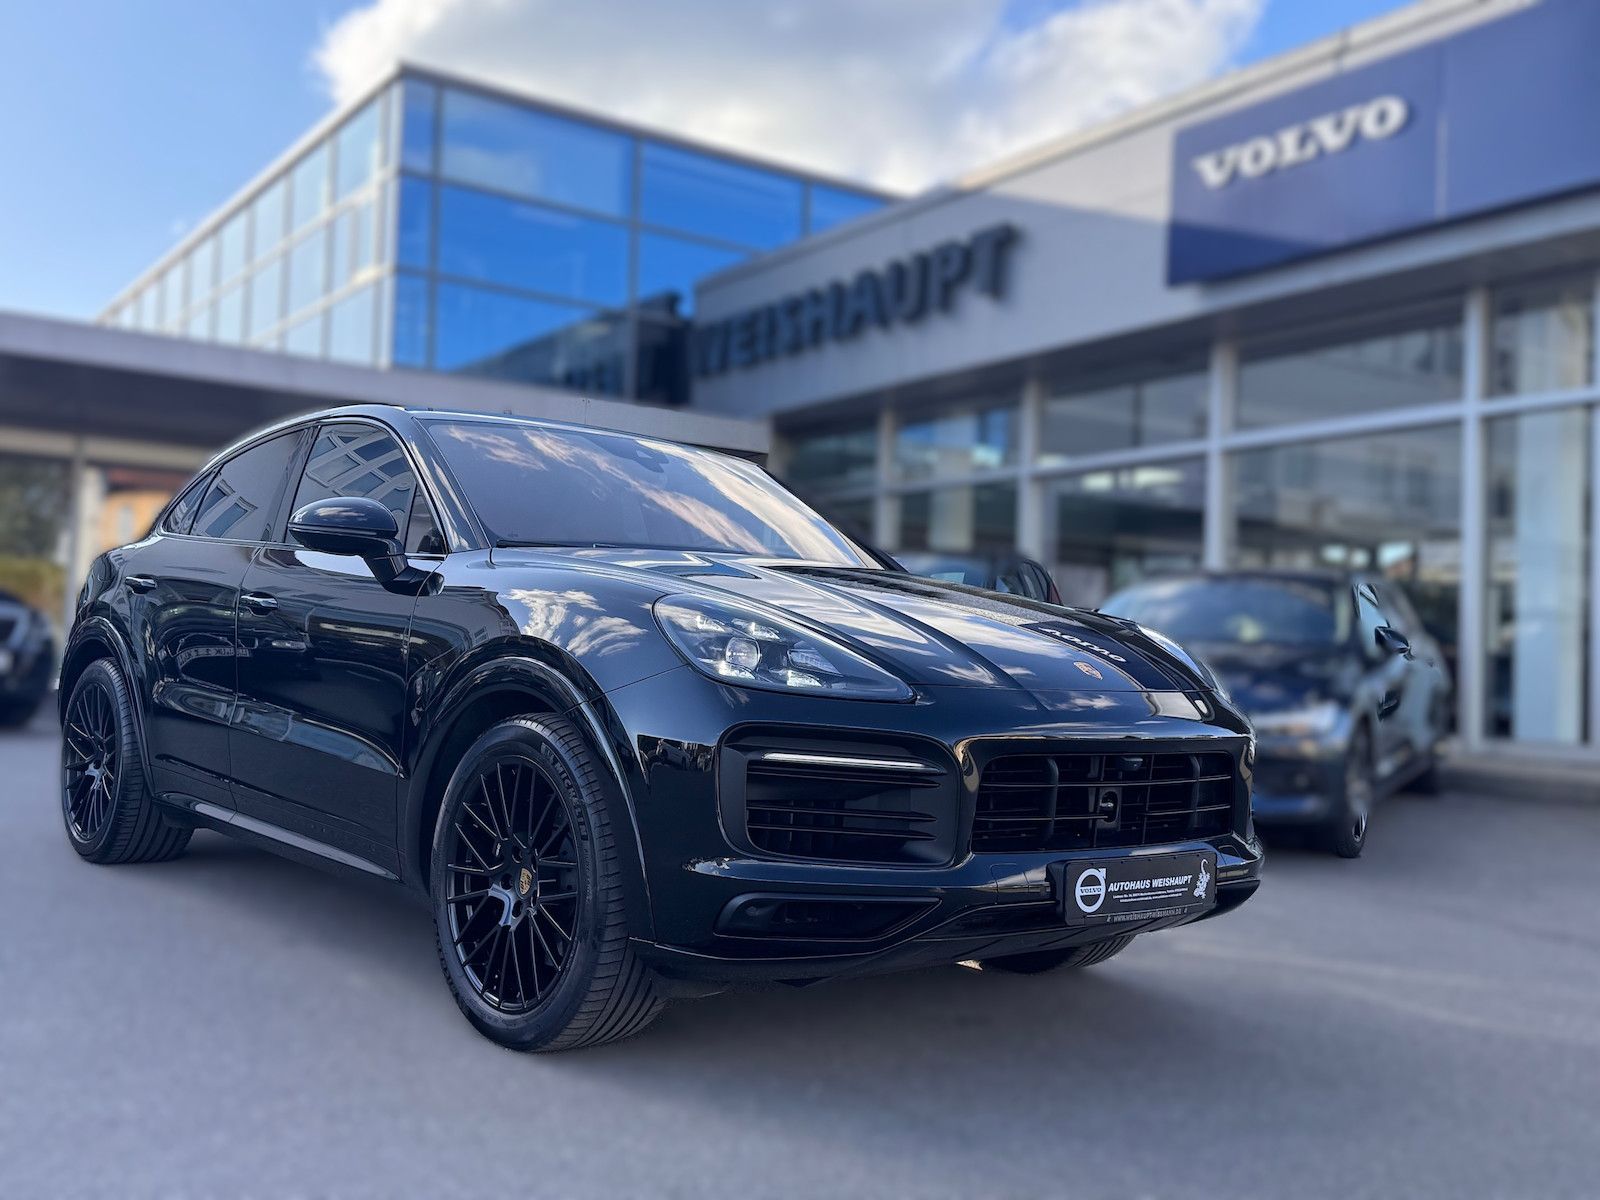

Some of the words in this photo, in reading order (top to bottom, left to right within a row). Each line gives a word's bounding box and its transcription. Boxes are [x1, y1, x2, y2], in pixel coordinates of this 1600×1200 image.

[1192, 96, 1408, 190] VOLVO
[691, 224, 1021, 376] WEISHAUPT
[1108, 879, 1151, 892] AUTOHAUS
[1152, 875, 1193, 888] WEISHAUPT
